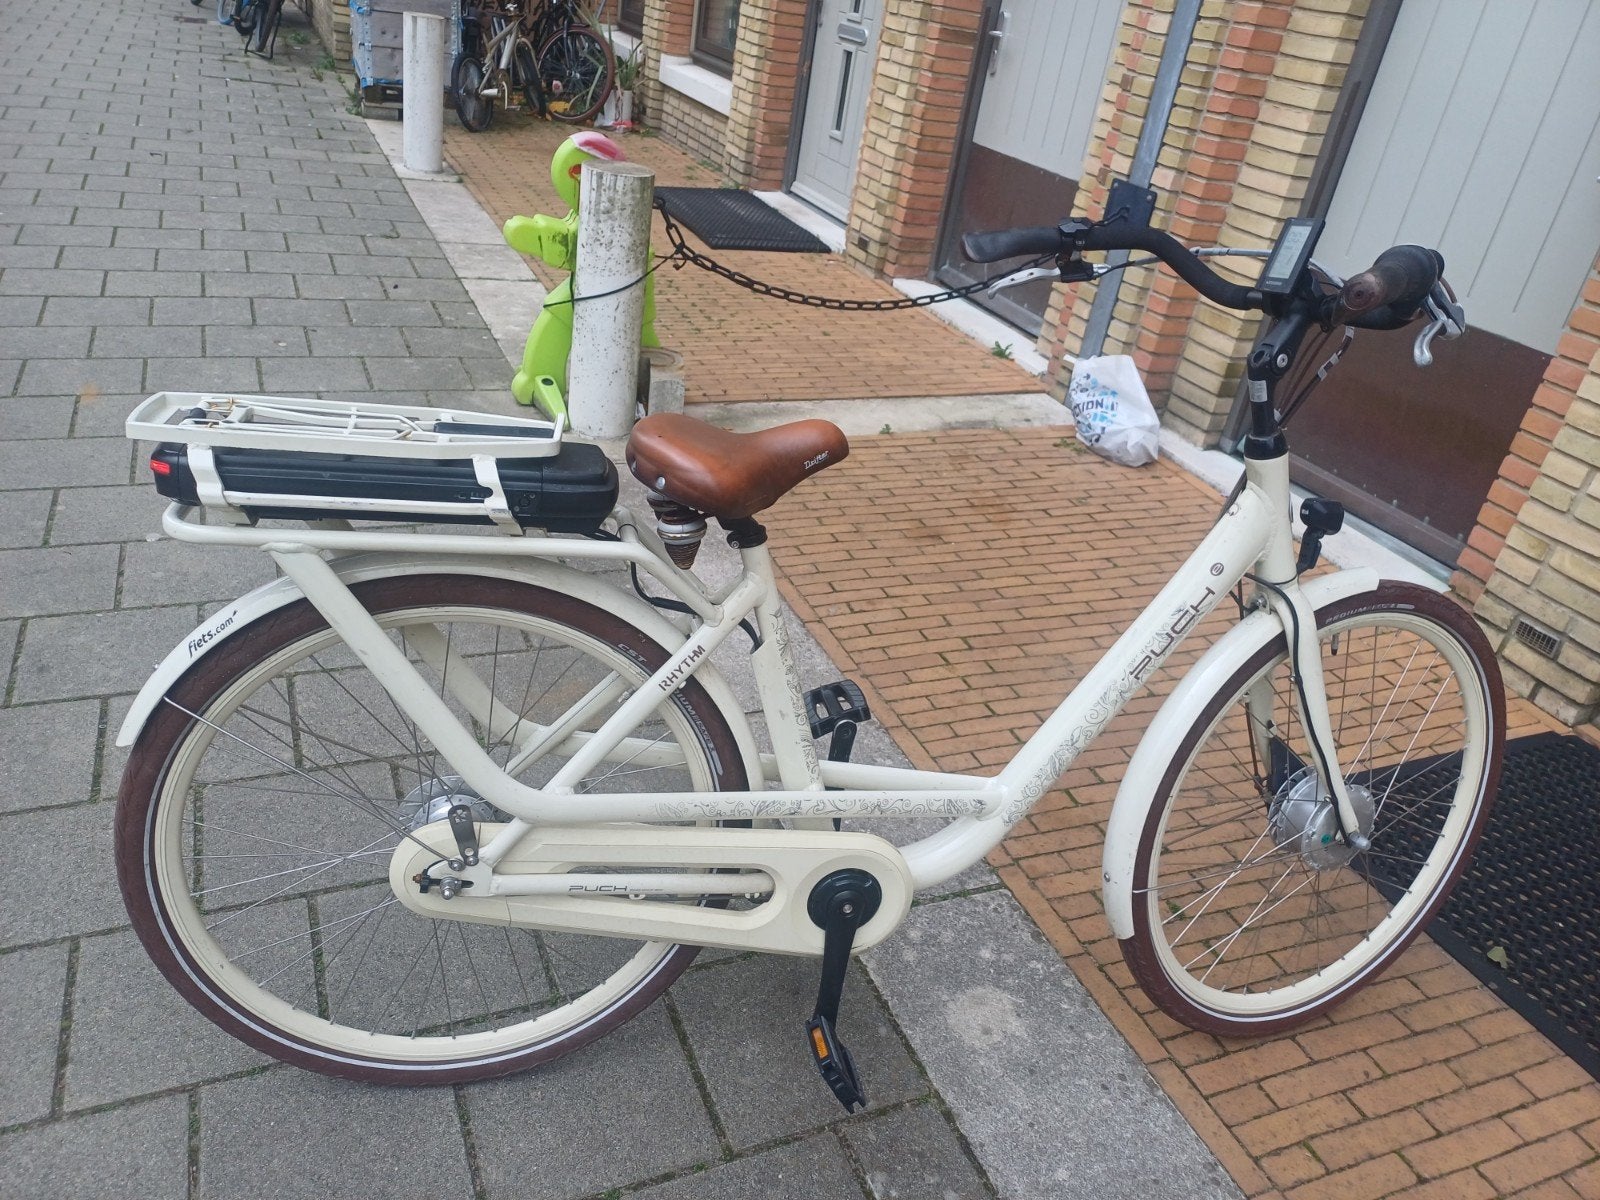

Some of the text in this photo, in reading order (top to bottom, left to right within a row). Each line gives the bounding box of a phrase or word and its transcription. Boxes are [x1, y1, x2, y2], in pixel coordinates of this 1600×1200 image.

[803, 450, 829, 470] Drifter
[188, 613, 236, 659] fiets.com
[617, 643, 647, 662] CST
[1129, 586, 1216, 681] PUCH
[658, 644, 706, 692] RHYTHM
